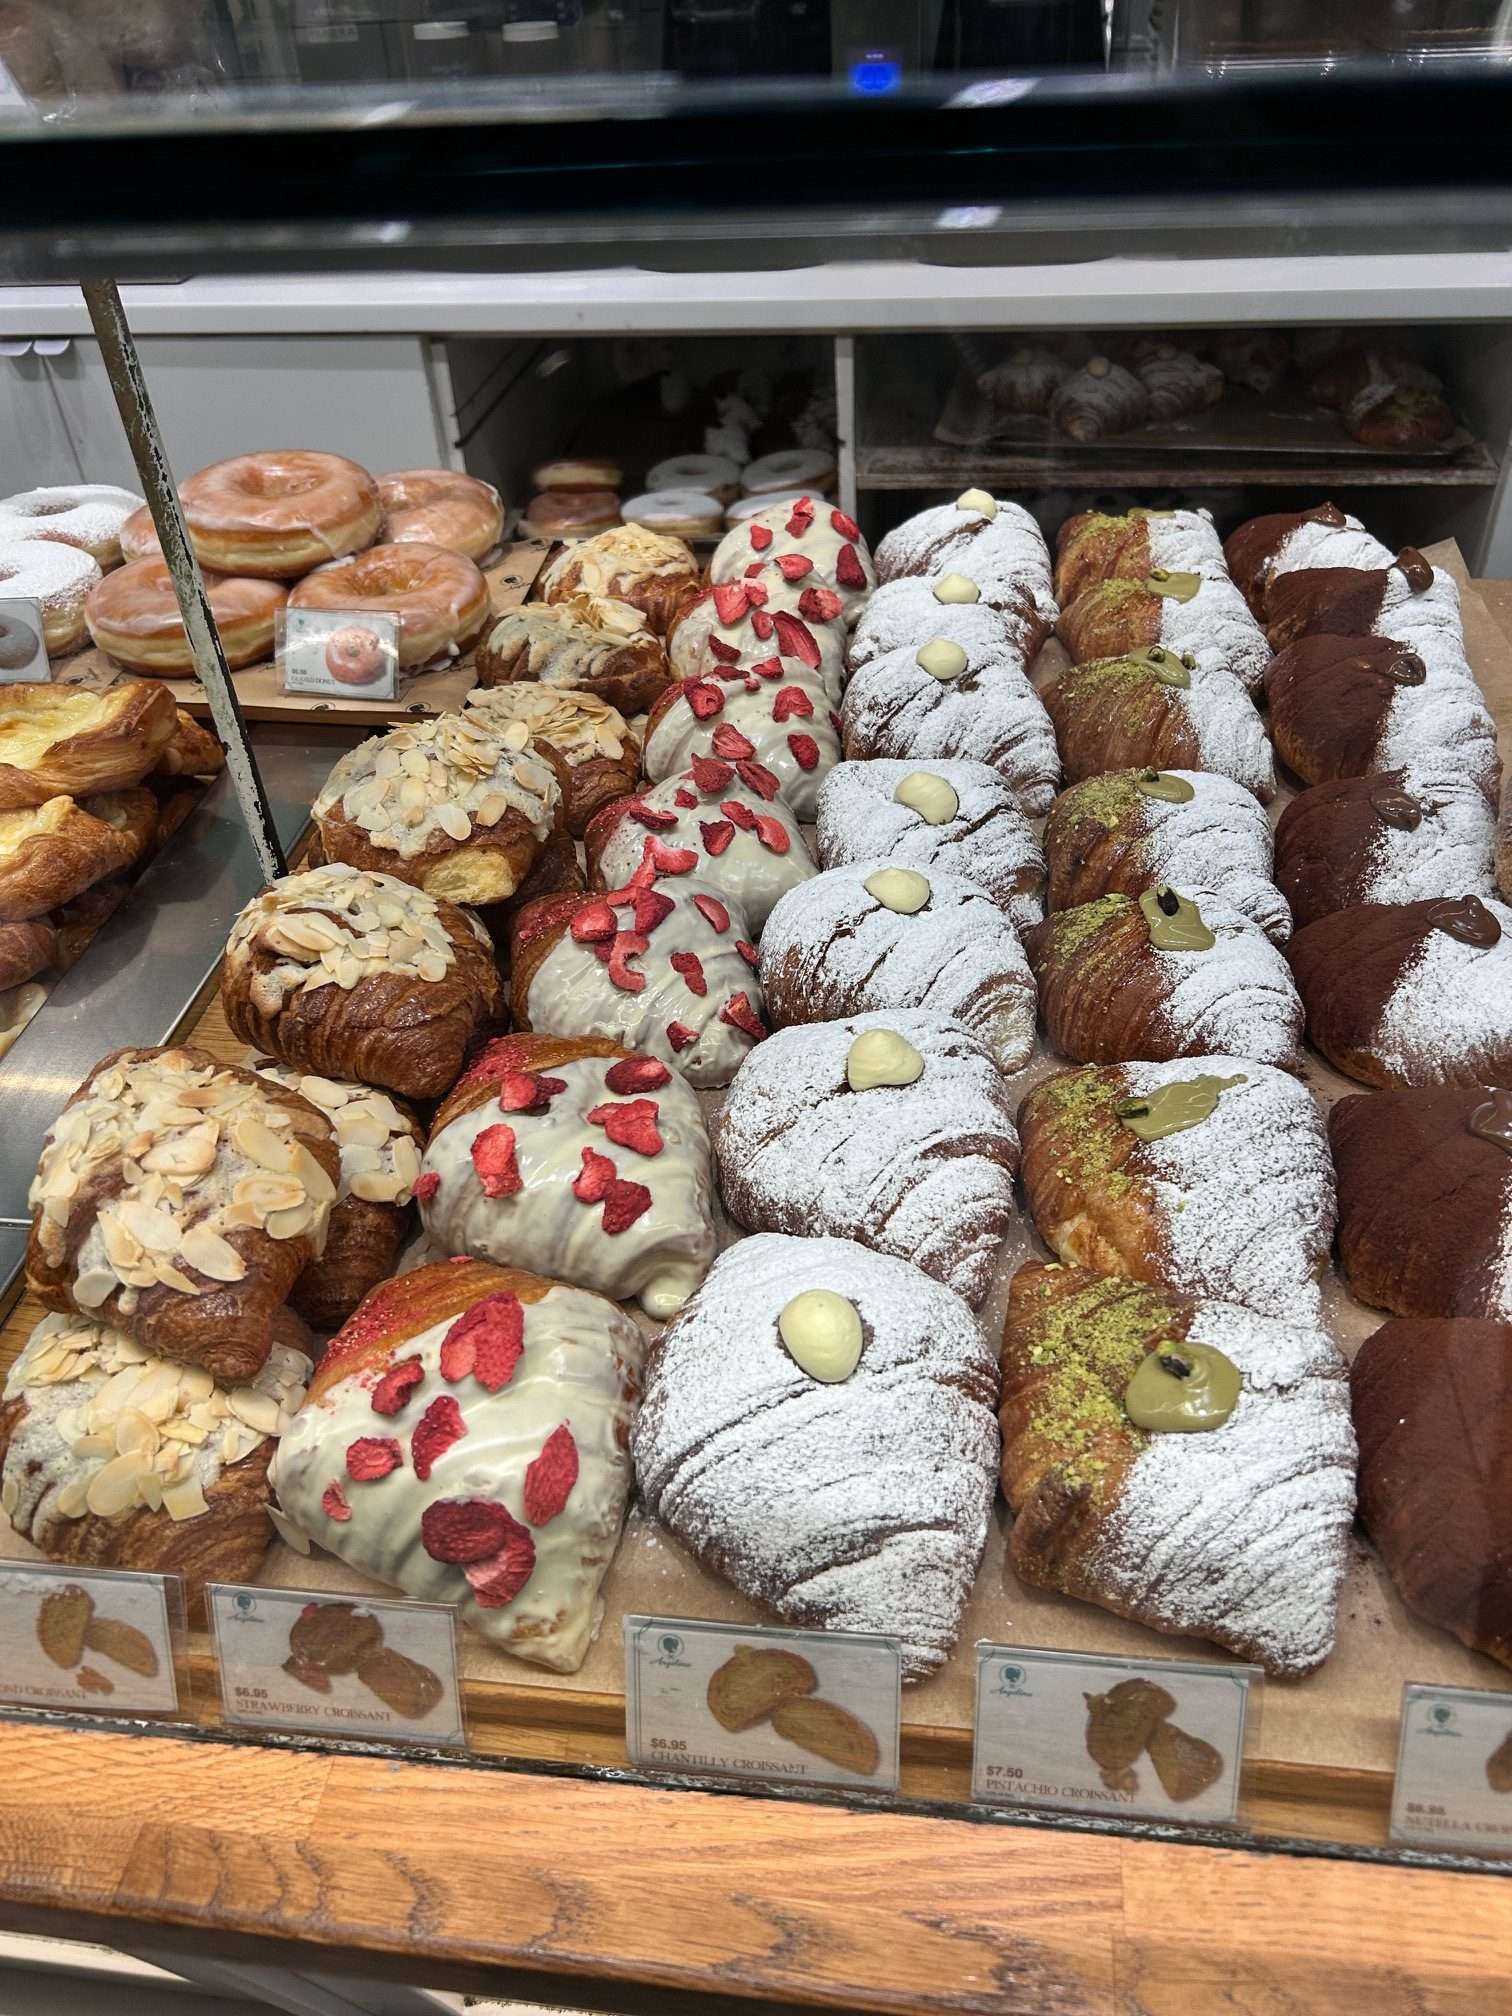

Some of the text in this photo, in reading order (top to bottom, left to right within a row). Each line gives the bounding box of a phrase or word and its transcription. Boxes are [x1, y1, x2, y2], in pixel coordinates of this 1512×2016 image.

[236, 1699, 393, 1721] STRAWBERRY CROISSANT
[650, 1737, 687, 1751] $6.95
[651, 1750, 729, 1768] CHANTILLY
[986, 1765, 1023, 1779] $7.50
[986, 1779, 1058, 1796] PISTACHIO
[1061, 1786, 1136, 1804] CROISSANT
